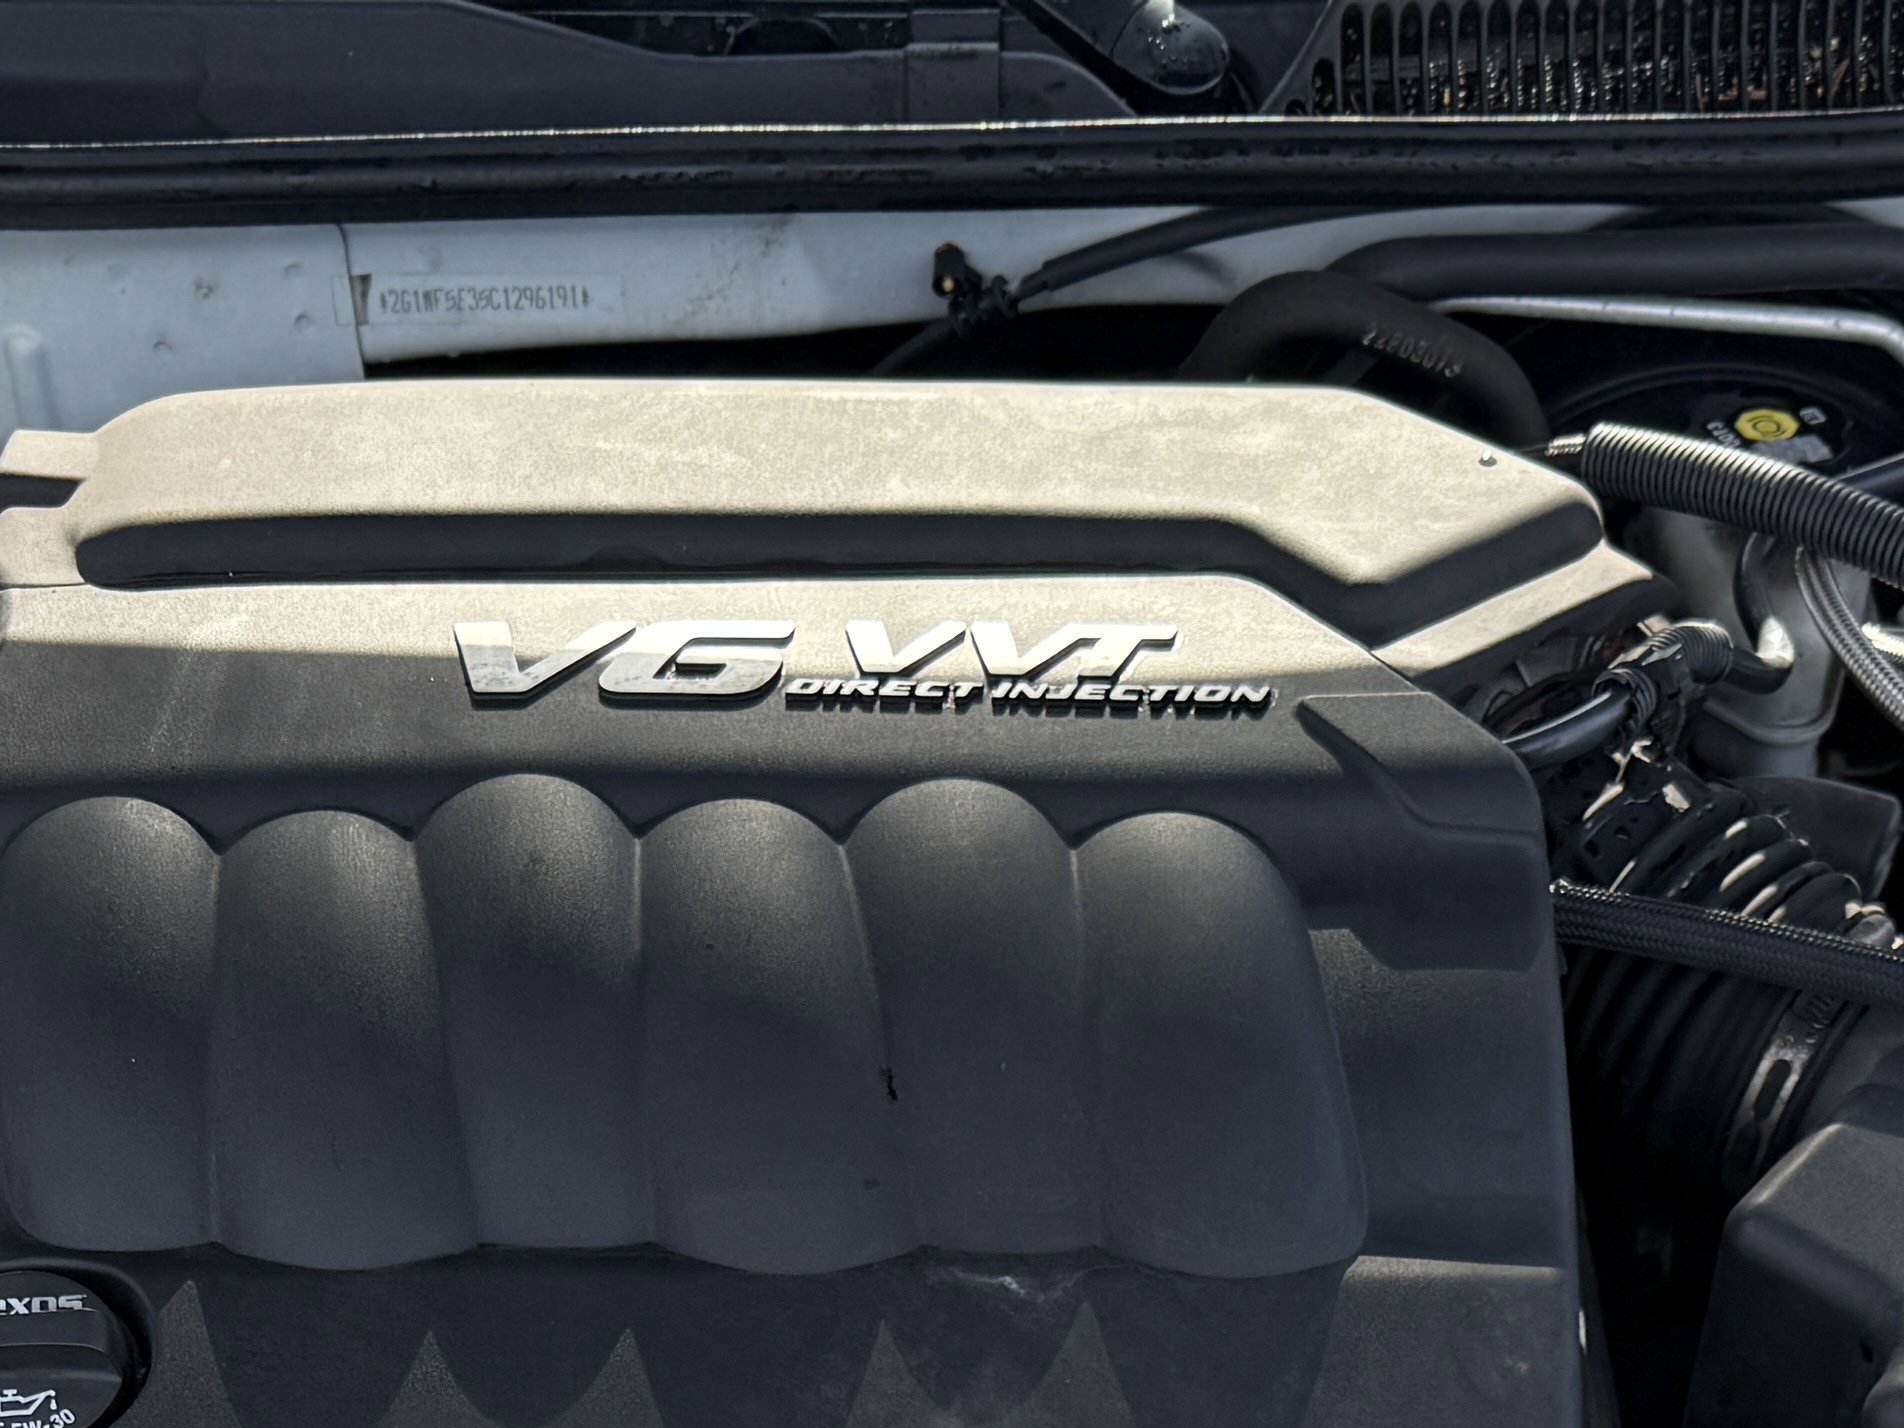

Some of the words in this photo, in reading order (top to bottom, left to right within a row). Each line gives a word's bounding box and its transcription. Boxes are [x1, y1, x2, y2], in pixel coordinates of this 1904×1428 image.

[453, 619, 796, 695] V6
[845, 619, 1179, 677] VVT
[785, 678, 985, 700] DIRECT
[991, 682, 1275, 705] INJECTION
